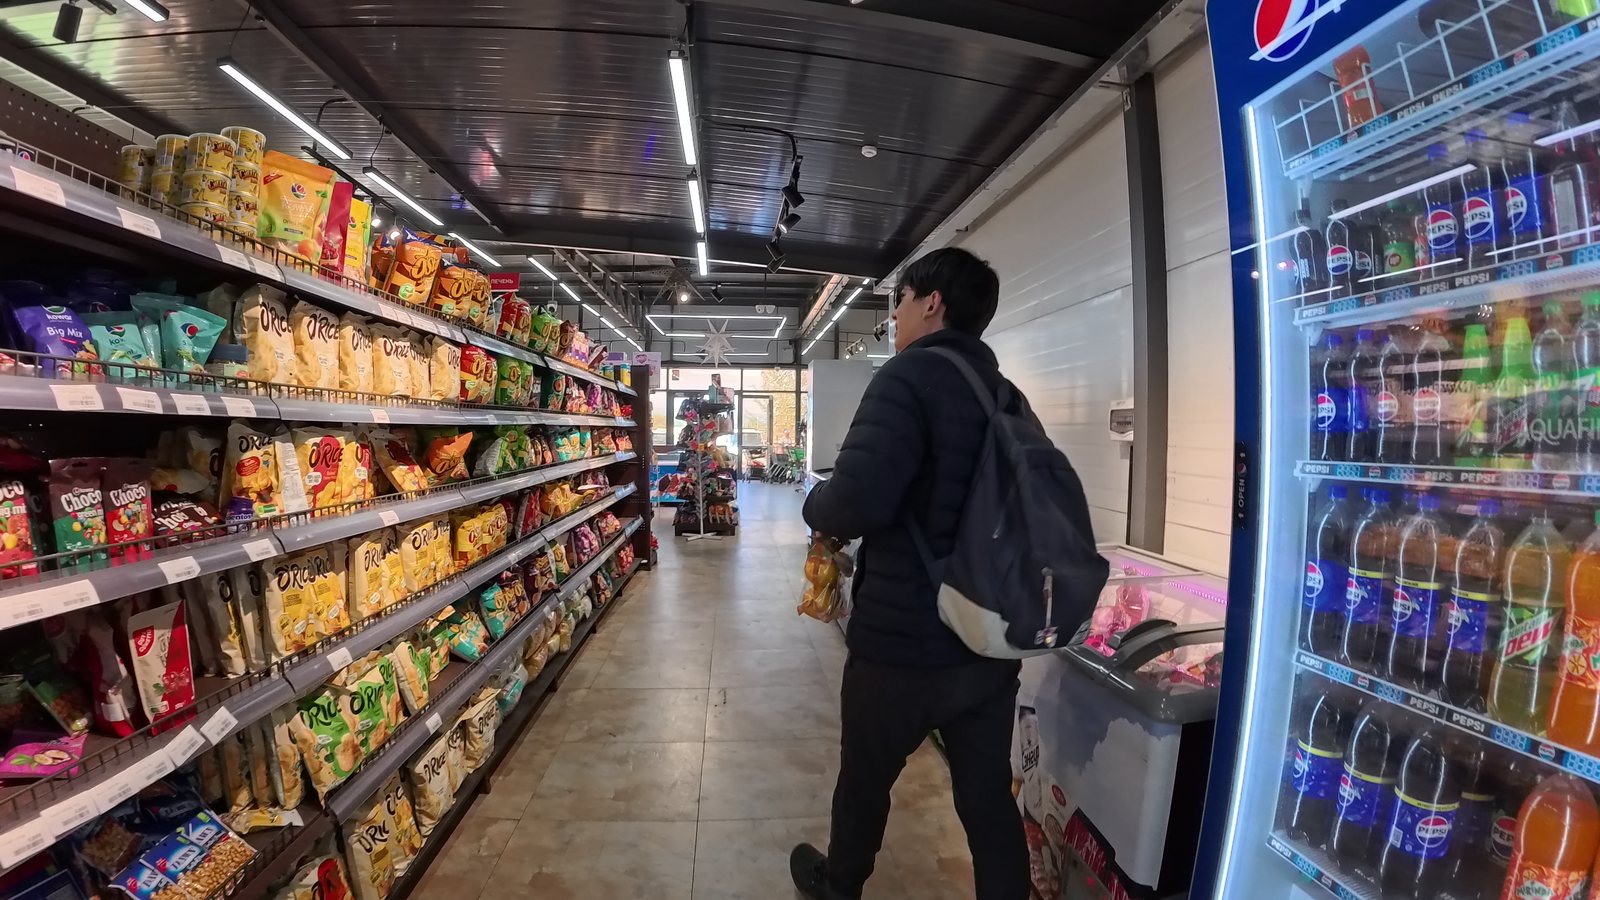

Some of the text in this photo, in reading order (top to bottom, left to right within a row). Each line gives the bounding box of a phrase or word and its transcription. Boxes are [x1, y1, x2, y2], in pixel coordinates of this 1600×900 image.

[1432, 83, 1463, 103] PEPSI
[1397, 101, 1426, 120] PEPSI
[1290, 154, 1313, 169] PEPSI
[1428, 224, 1457, 235] PEPSI
[1455, 273, 1489, 287] PEPSI
[1420, 282, 1449, 295] PEPSI
[1303, 306, 1326, 318] PEPSI
[46, 327, 83, 338] Big Mix
[1305, 465, 1330, 474] PEPSI
[1460, 472, 1498, 484] PEPSI
[109, 486, 146, 507] Choco
[1237, 479, 1246, 507] OPEN
[61, 489, 103, 513] Choco
[1301, 655, 1323, 669] PEPSI
[1410, 697, 1439, 715] PEPSI
[1453, 713, 1485, 732] PEPSI
[1418, 827, 1448, 836] PEPSI
[1271, 839, 1291, 858] PEPSI
